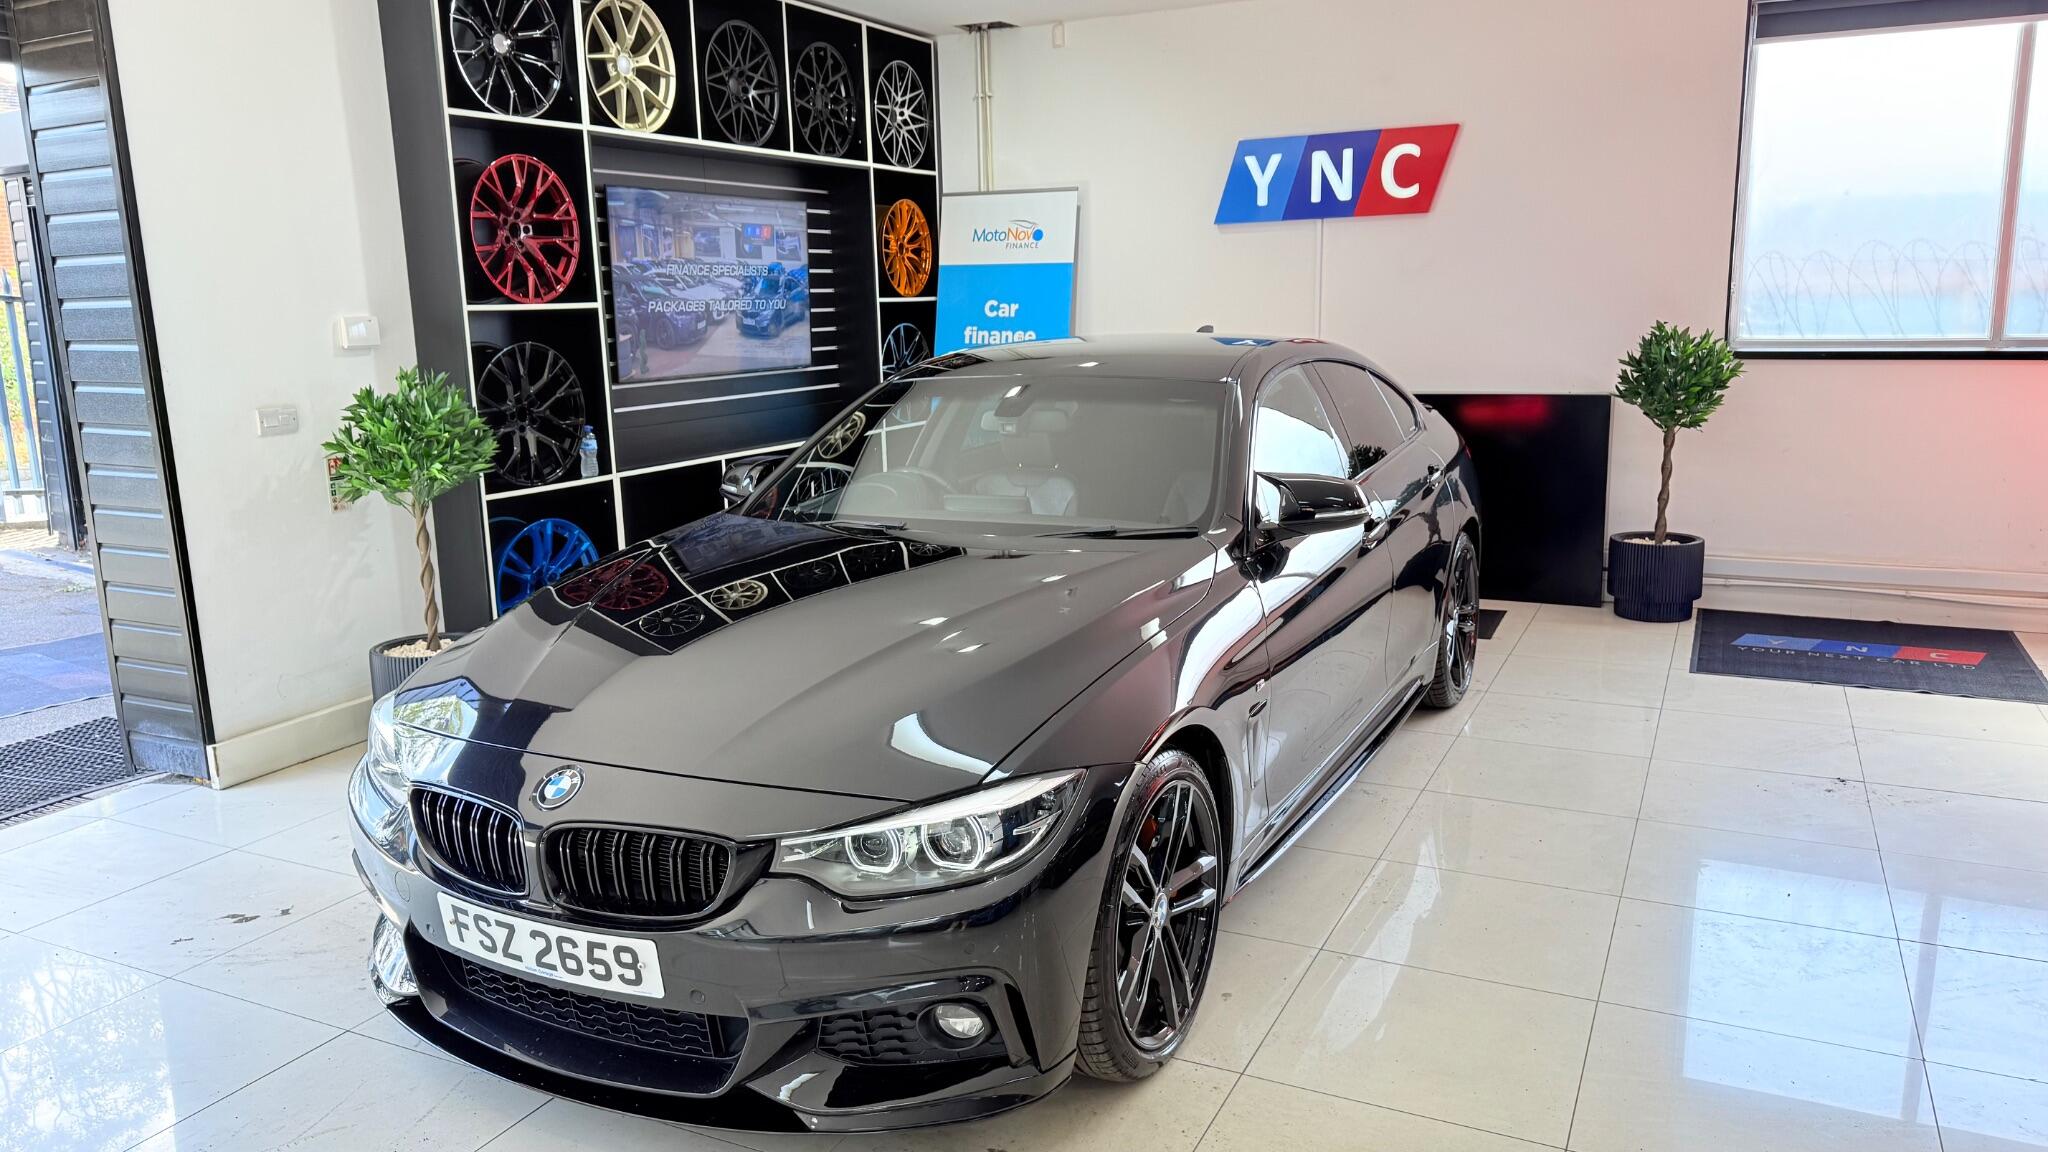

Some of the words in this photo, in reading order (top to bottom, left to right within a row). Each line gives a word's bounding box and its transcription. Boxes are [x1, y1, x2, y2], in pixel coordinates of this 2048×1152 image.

[666, 264, 710, 276] FINANCE
[711, 264, 769, 276] SPECIALISTS
[648, 301, 706, 313] PACKAGES
[709, 300, 752, 312] TAILORED
[755, 300, 766, 310] TO
[768, 299, 787, 310] YOU
[984, 299, 1019, 318] Car
[964, 326, 1036, 345] finance
[1738, 646, 1795, 655] YOUR
[1808, 651, 1863, 660] NEXT
[1876, 657, 1920, 666] CAR
[1933, 662, 1975, 670] LTD
[450, 903, 524, 964] FSZ
[529, 929, 644, 987] 2659
